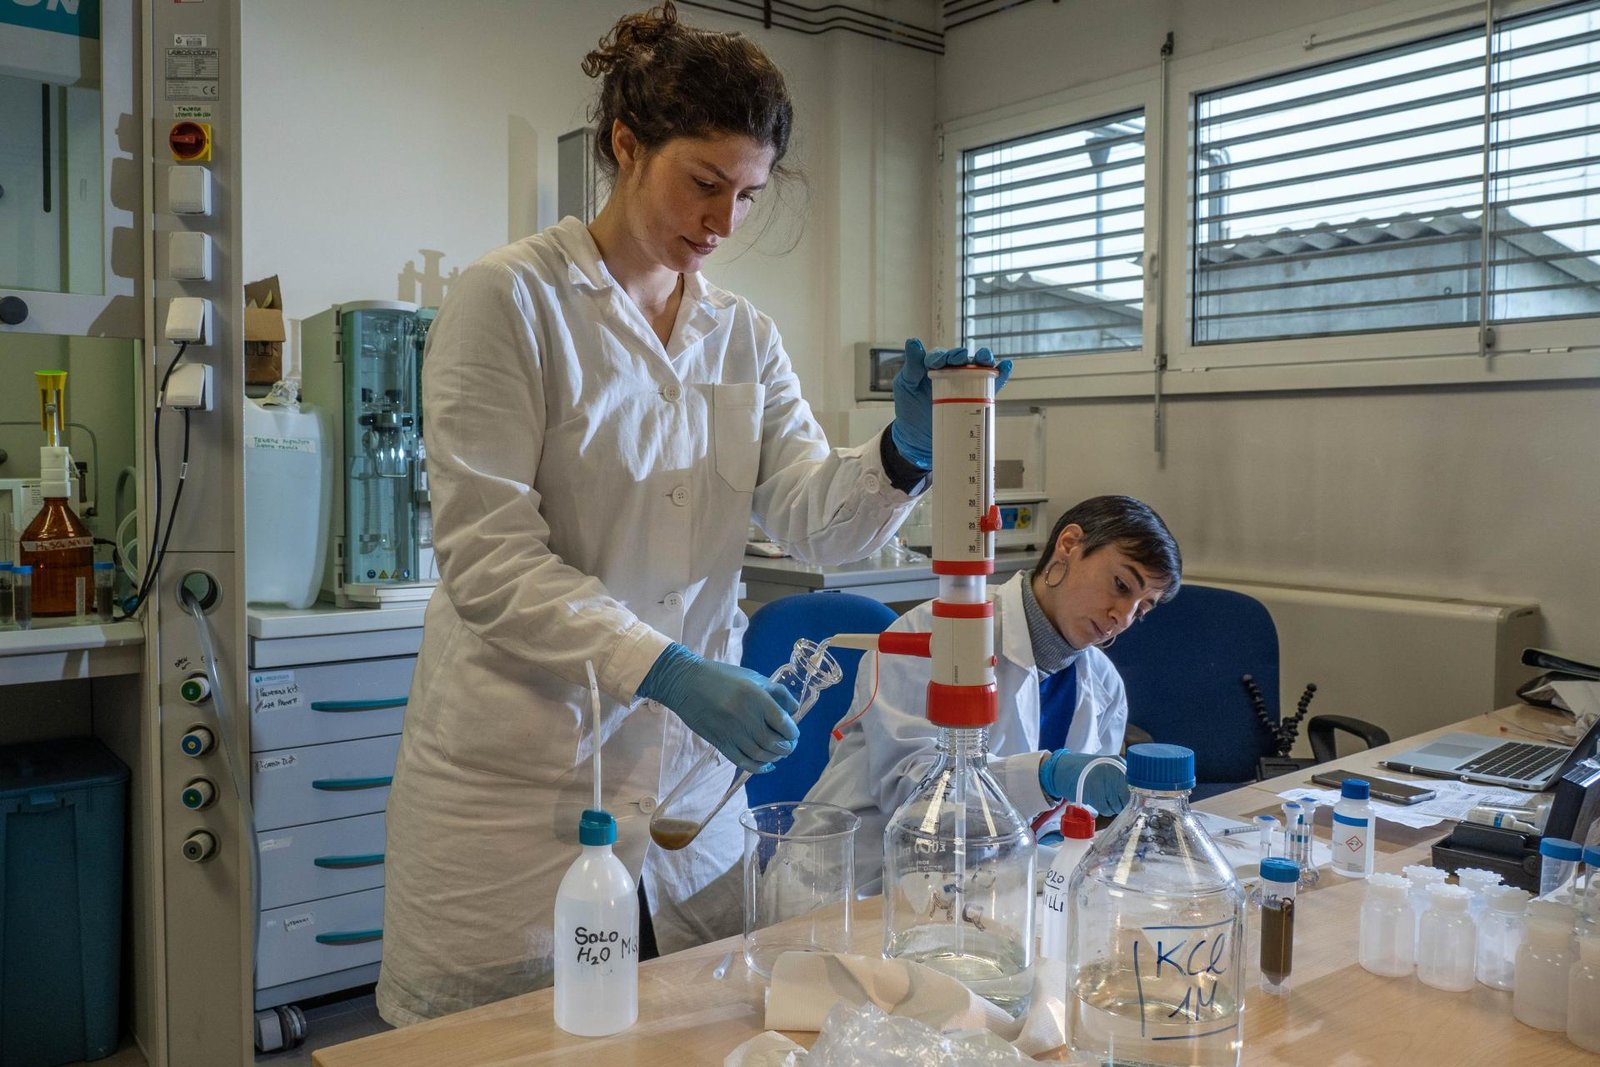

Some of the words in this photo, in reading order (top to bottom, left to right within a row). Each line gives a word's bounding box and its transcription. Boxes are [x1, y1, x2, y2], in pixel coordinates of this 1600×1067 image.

[968, 453, 976, 461] 10
[968, 499, 976, 507] 20
[575, 927, 618, 945] SOLO
